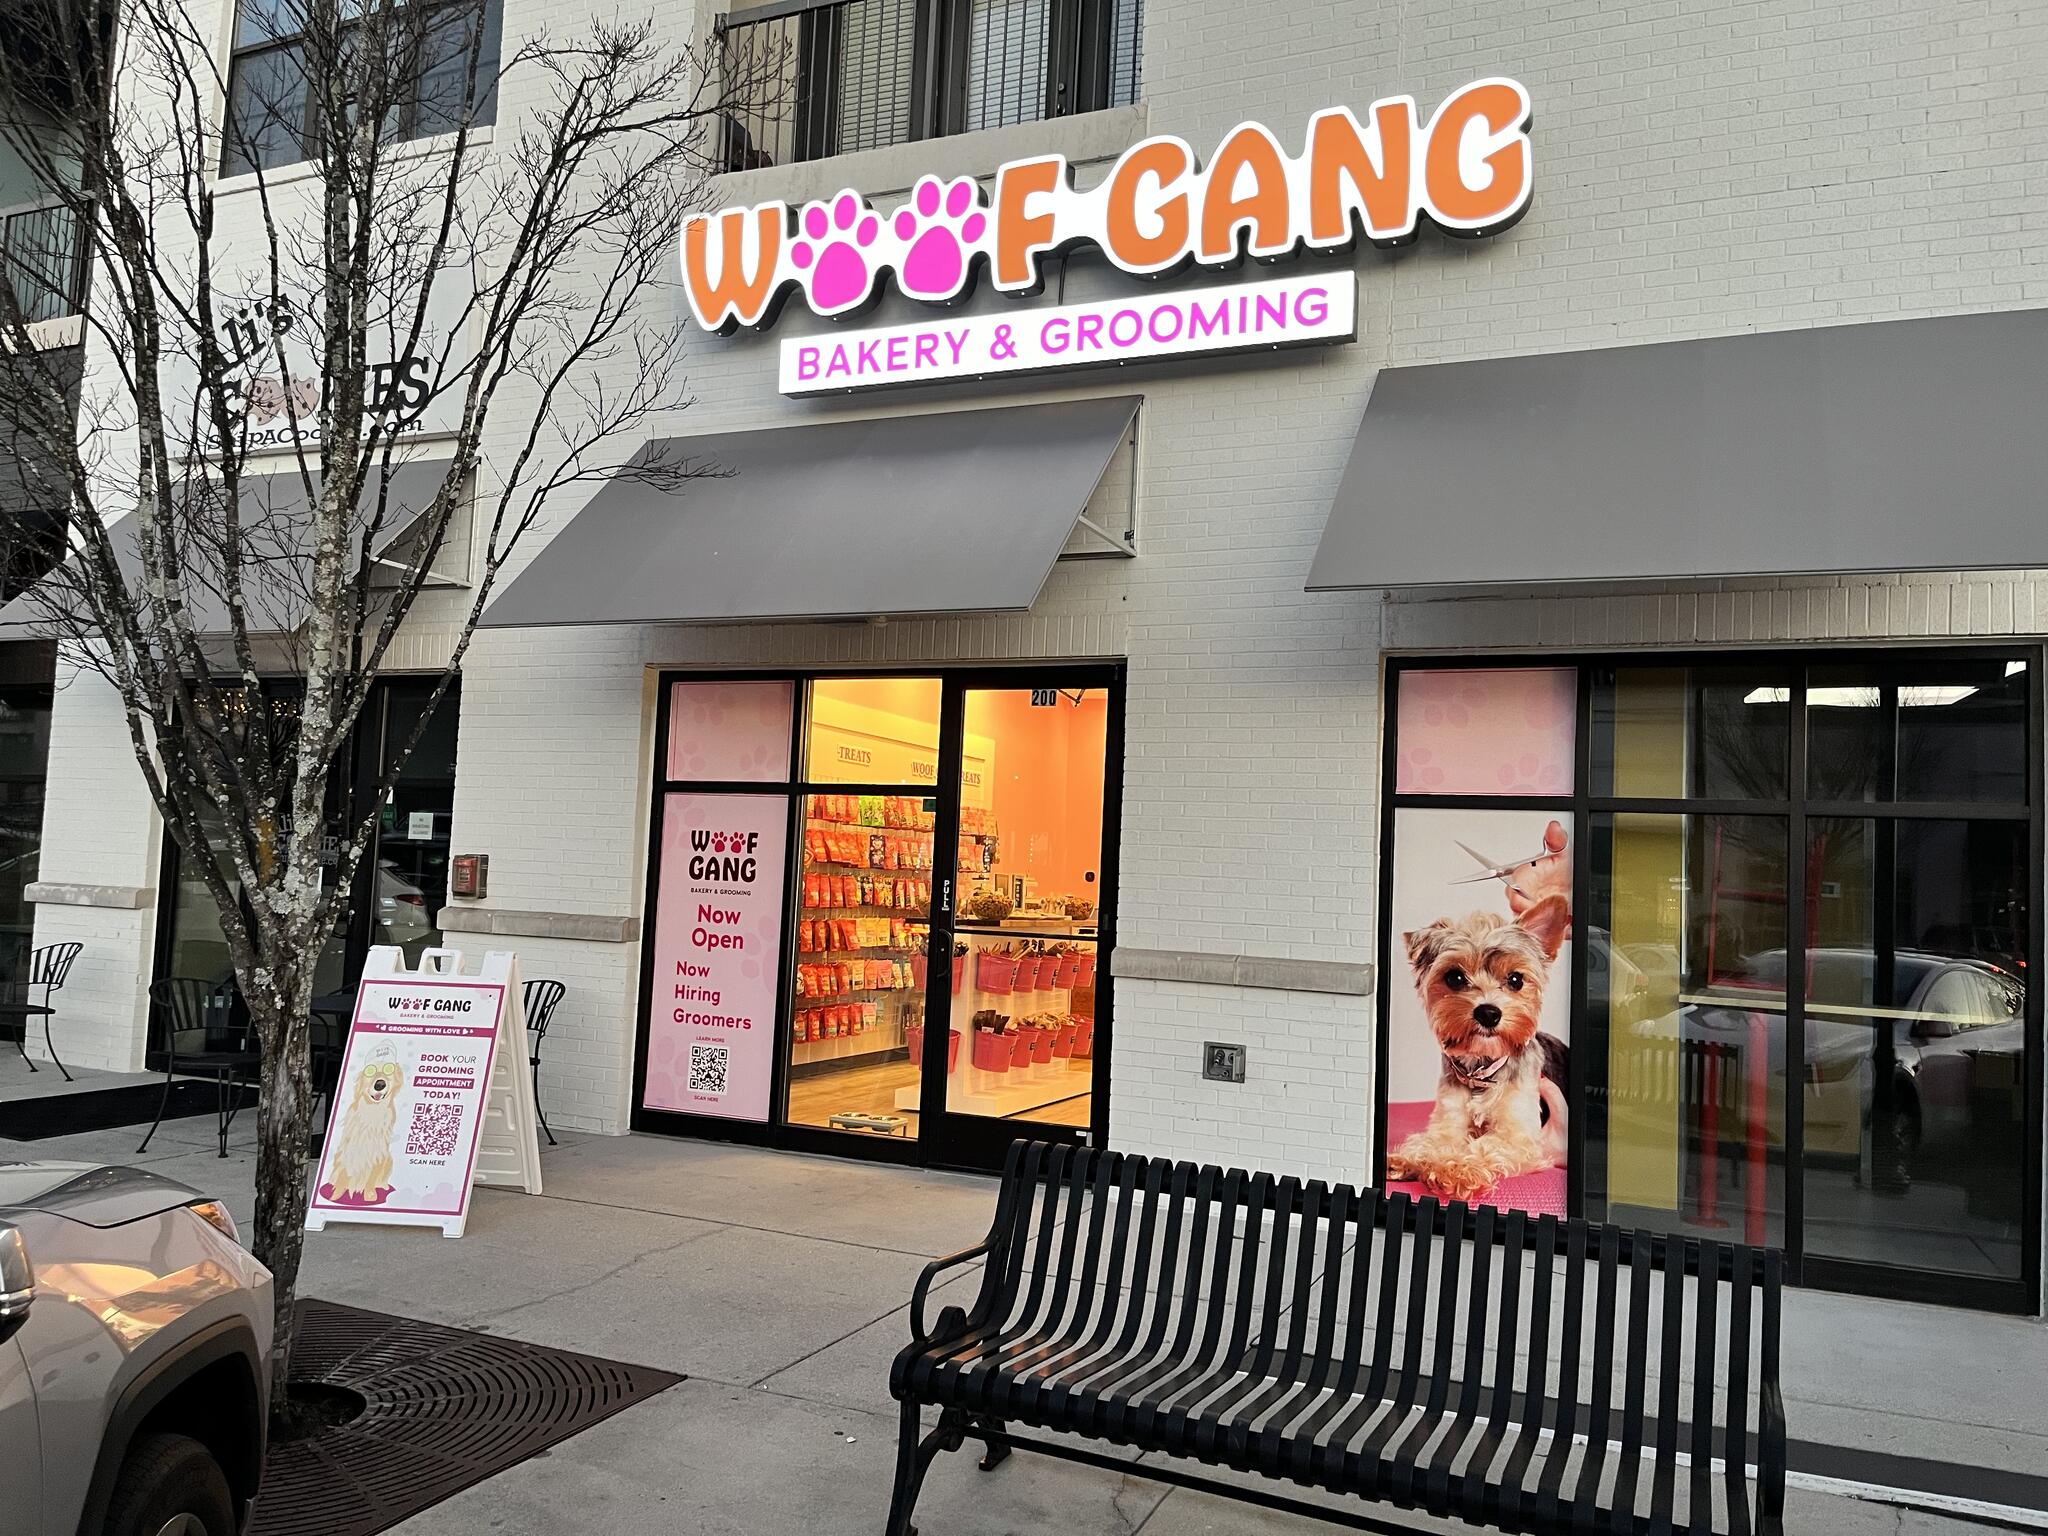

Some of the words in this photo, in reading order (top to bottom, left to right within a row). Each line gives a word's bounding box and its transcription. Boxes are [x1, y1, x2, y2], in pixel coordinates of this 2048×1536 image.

[1106, 84, 1524, 267] GANG
[797, 328, 968, 381] BAKERY
[989, 323, 1017, 361] &
[1039, 287, 1329, 355] GROOMING
[1032, 690, 1056, 706] 200
[689, 856, 756, 883] GANG
[697, 903, 741, 925] Now
[691, 927, 743, 952] Open
[676, 960, 710, 978] Now
[674, 984, 721, 1006] Hiring
[434, 999, 472, 1013] GANG
[673, 1008, 752, 1030] Groomers
[388, 1025, 424, 1033] GROOMING
[420, 1053, 448, 1063] BOOK
[452, 1055, 477, 1064] YOUR
[418, 1065, 475, 1075] GROOMING
[415, 1078, 472, 1087] APPOINTMENT
[423, 1090, 461, 1100] TODAY!
